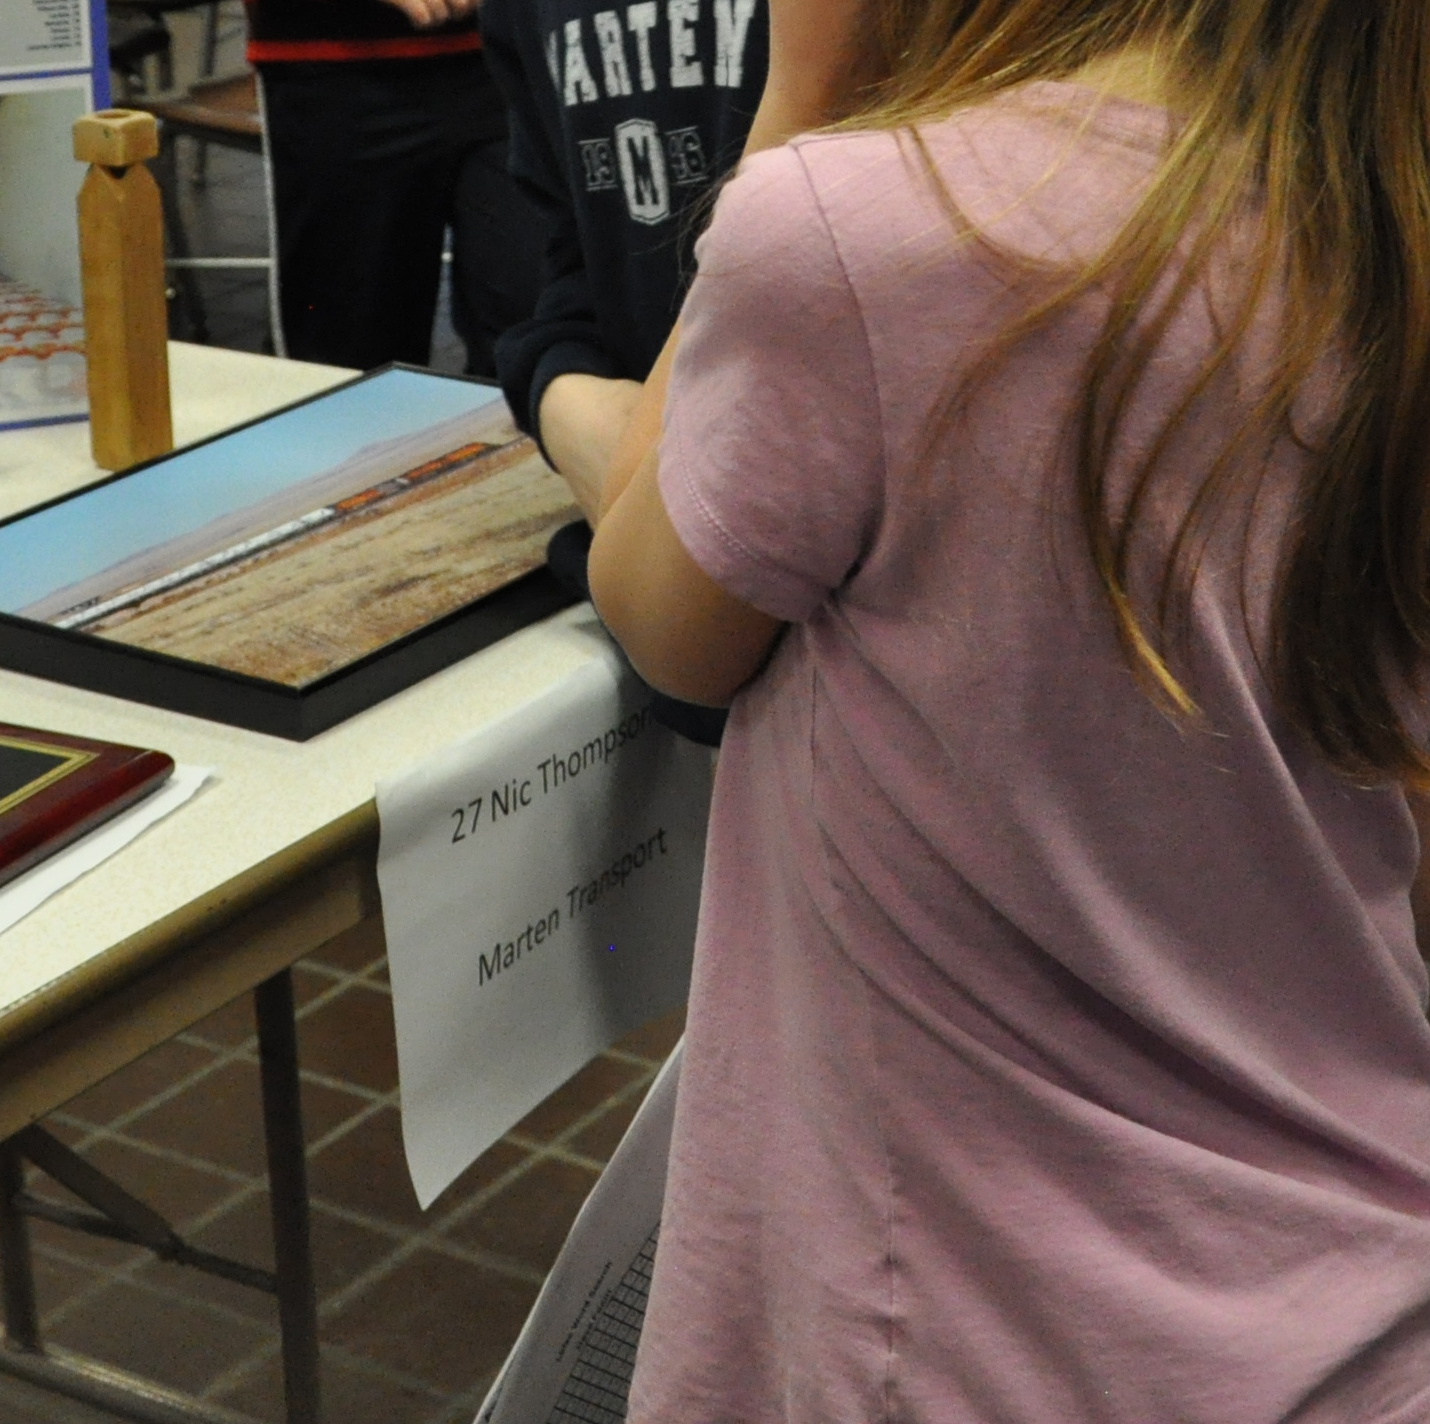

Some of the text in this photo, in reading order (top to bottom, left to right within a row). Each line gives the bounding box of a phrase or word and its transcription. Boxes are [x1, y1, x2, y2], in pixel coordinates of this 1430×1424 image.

[452, 797, 482, 844] 27
[491, 778, 532, 823] Nic
[478, 826, 668, 986] Marten Transport
